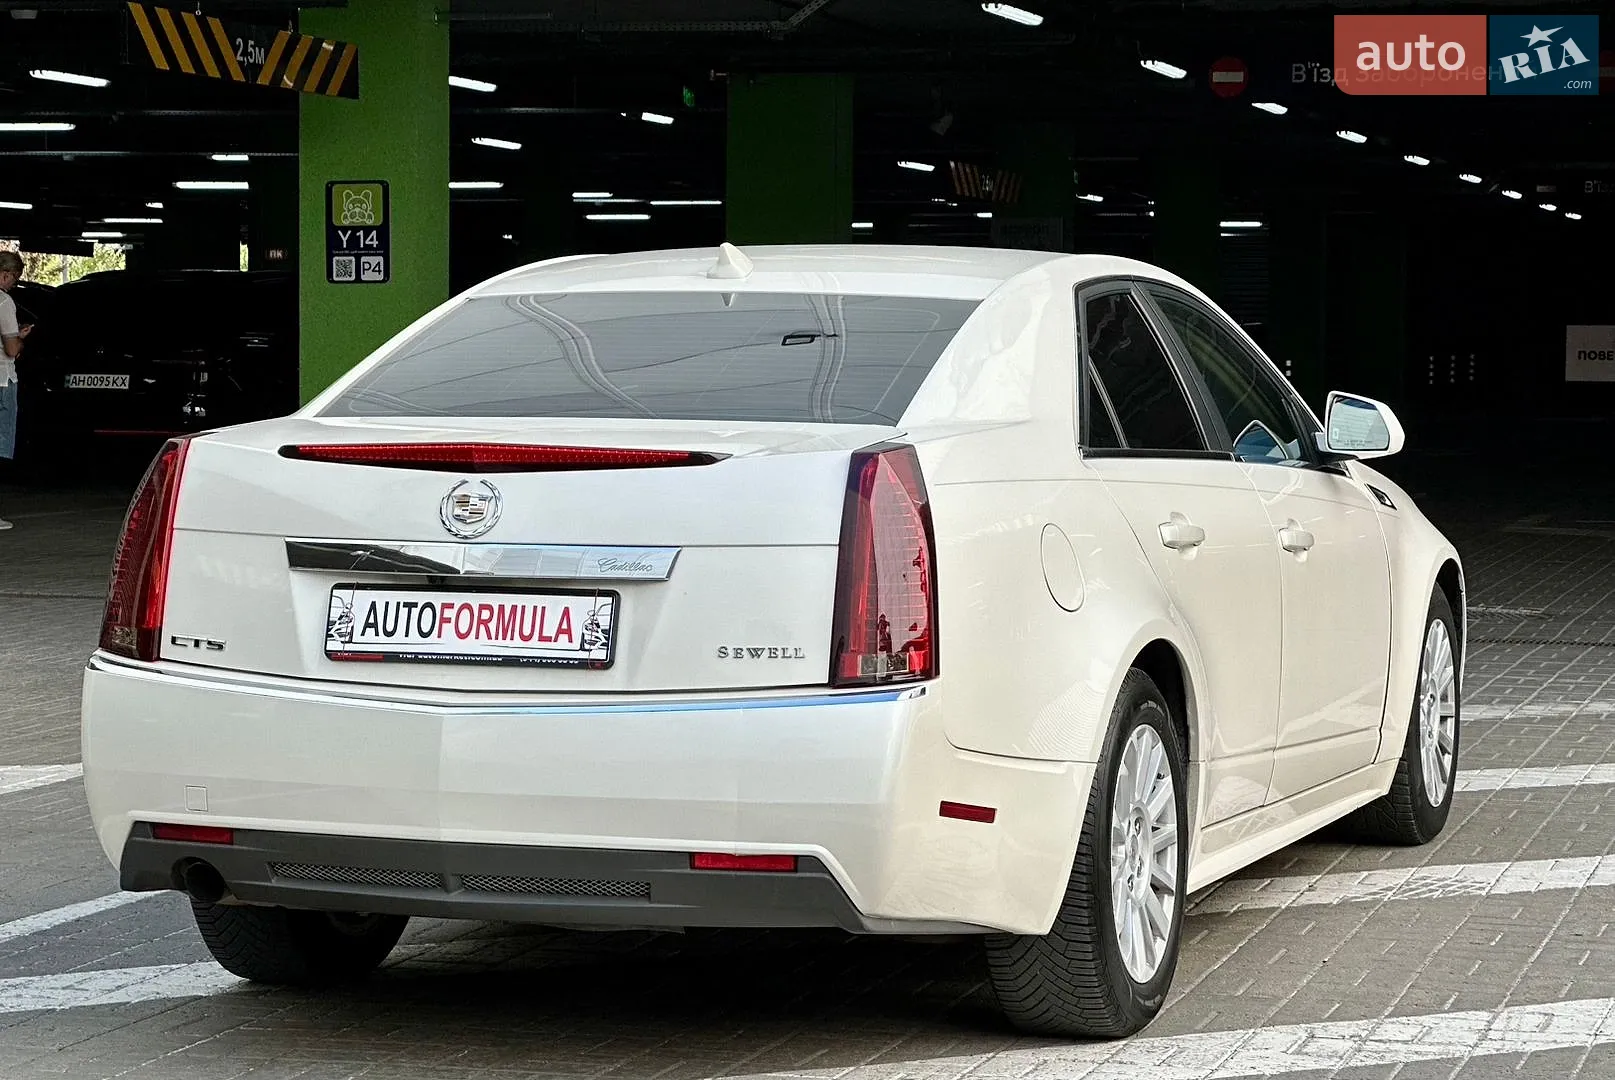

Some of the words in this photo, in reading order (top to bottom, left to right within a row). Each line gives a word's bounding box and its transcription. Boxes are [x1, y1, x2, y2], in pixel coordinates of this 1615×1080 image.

[337, 230, 352, 248] Y
[356, 230, 379, 248] 14
[361, 261, 382, 276] P4
[597, 557, 654, 573] Cadillac
[360, 600, 574, 644] AUTOFORMULA
[170, 634, 227, 651] CTS
[717, 645, 806, 660] SEWELL
